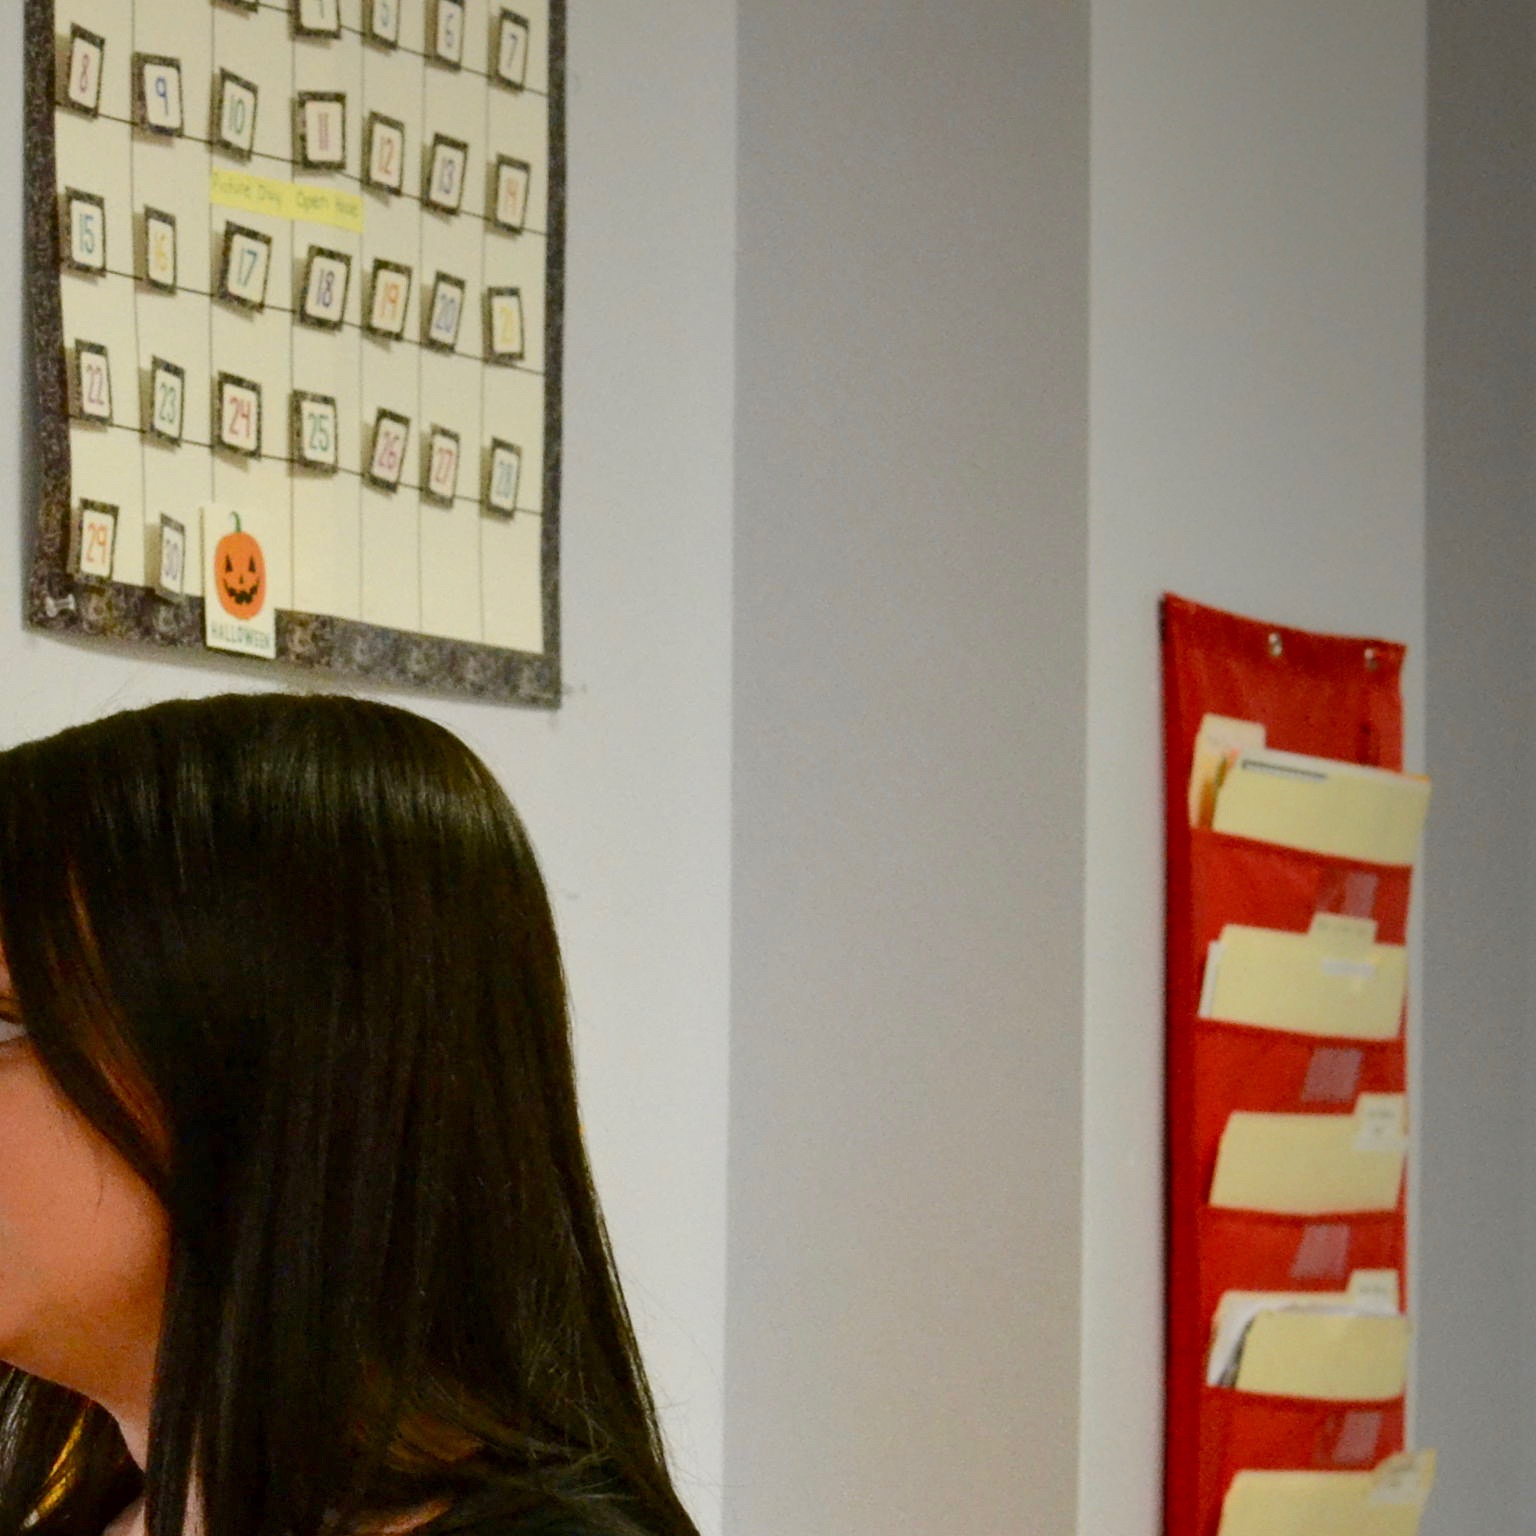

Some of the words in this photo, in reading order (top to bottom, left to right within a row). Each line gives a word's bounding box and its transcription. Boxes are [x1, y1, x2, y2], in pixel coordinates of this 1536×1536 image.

[445, 12, 456, 49] 6
[506, 31, 520, 70] 7
[78, 52, 91, 94] 8
[154, 75, 170, 117] 9
[229, 93, 246, 136] 10
[317, 110, 329, 152] 11
[378, 134, 395, 176] 12
[439, 155, 456, 196] 13
[78, 212, 96, 255] 15
[154, 230, 169, 273] 16
[236, 246, 258, 288] 17
[315, 267, 336, 309] 18
[379, 281, 401, 321] 19
[434, 292, 458, 335] 20
[84, 363, 106, 406] 22
[158, 380, 178, 425] 23
[229, 394, 253, 440] 24
[307, 411, 329, 453] 25
[377, 430, 402, 472] 26
[433, 446, 455, 485] 27
[85, 521, 109, 566] 29
[164, 537, 179, 582] 30
[210, 621, 273, 650] HALLOWEEN
